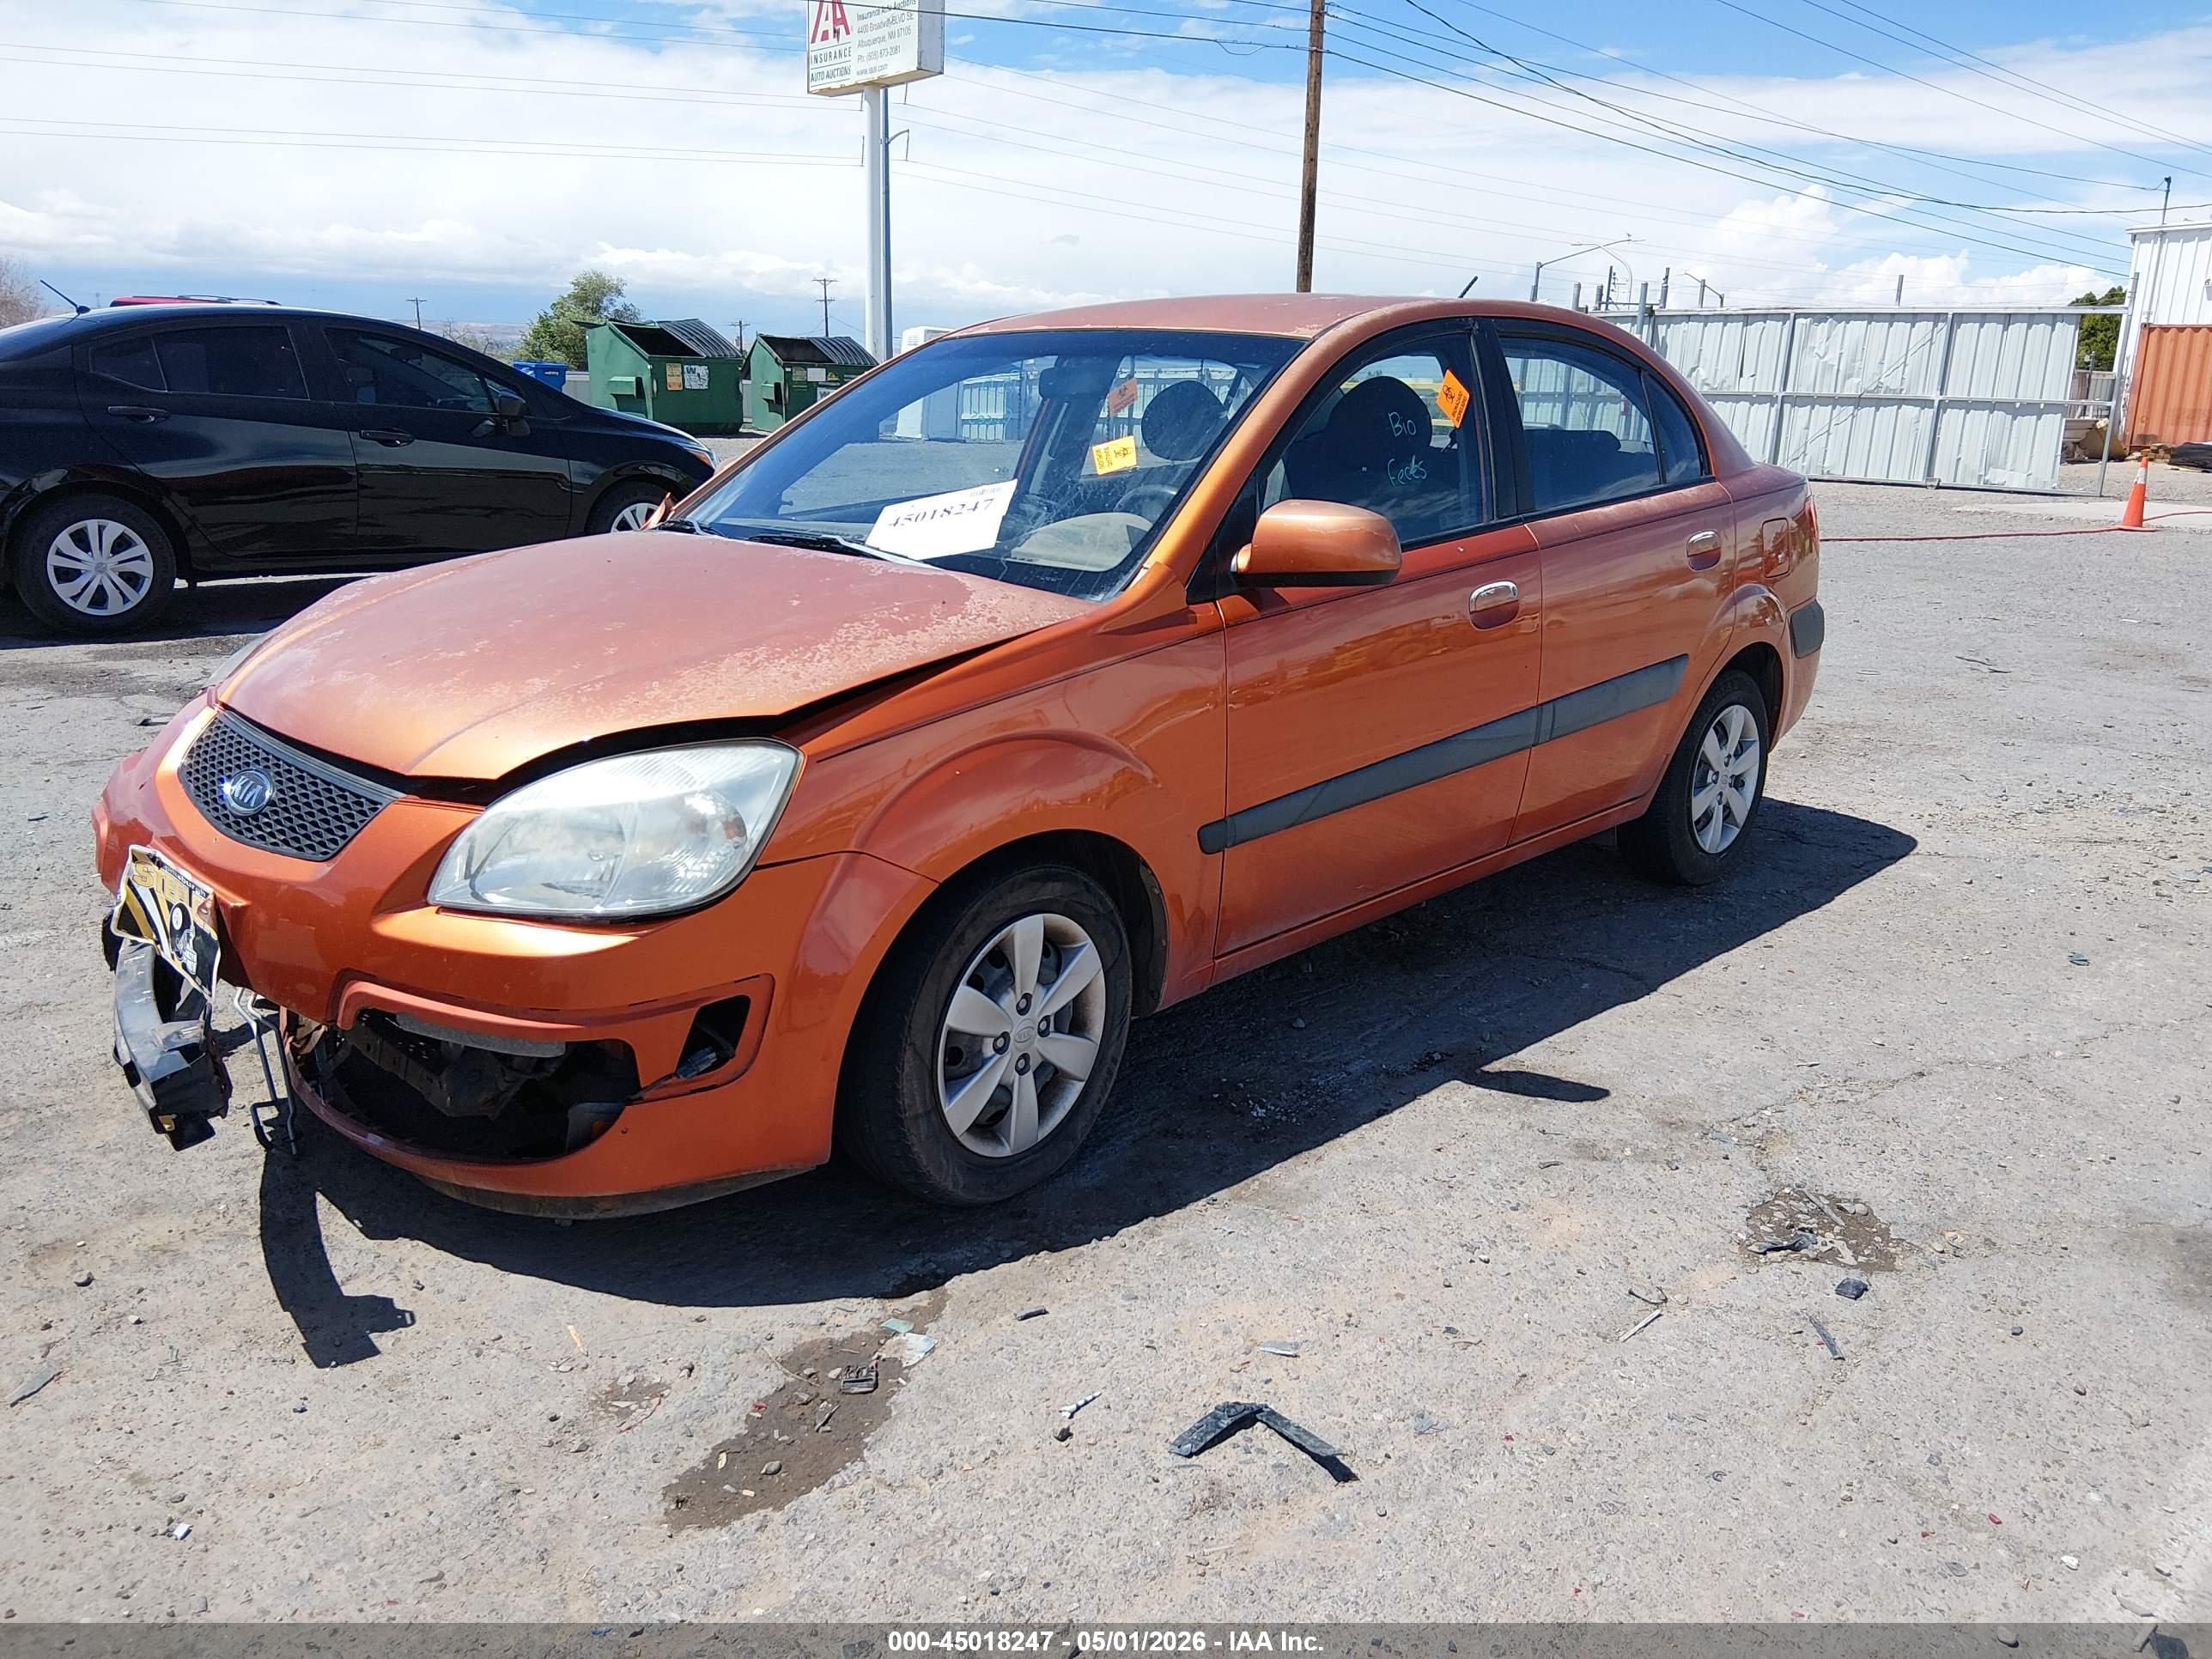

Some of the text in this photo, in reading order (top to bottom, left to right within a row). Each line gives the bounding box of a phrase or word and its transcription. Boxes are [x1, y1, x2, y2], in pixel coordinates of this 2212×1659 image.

[856, 9, 880, 21] Insurance
[869, 17, 891, 32] Broadway
[891, 12, 906, 25] BLVD
[906, 11, 915, 21] SE
[887, 29, 896, 40] NM
[810, 46, 852, 64] INSURANCE
[810, 64, 851, 83] AUTO AUCTIONS
[1388, 411, 1417, 437] Bio
[230, 775, 264, 807] KIA
